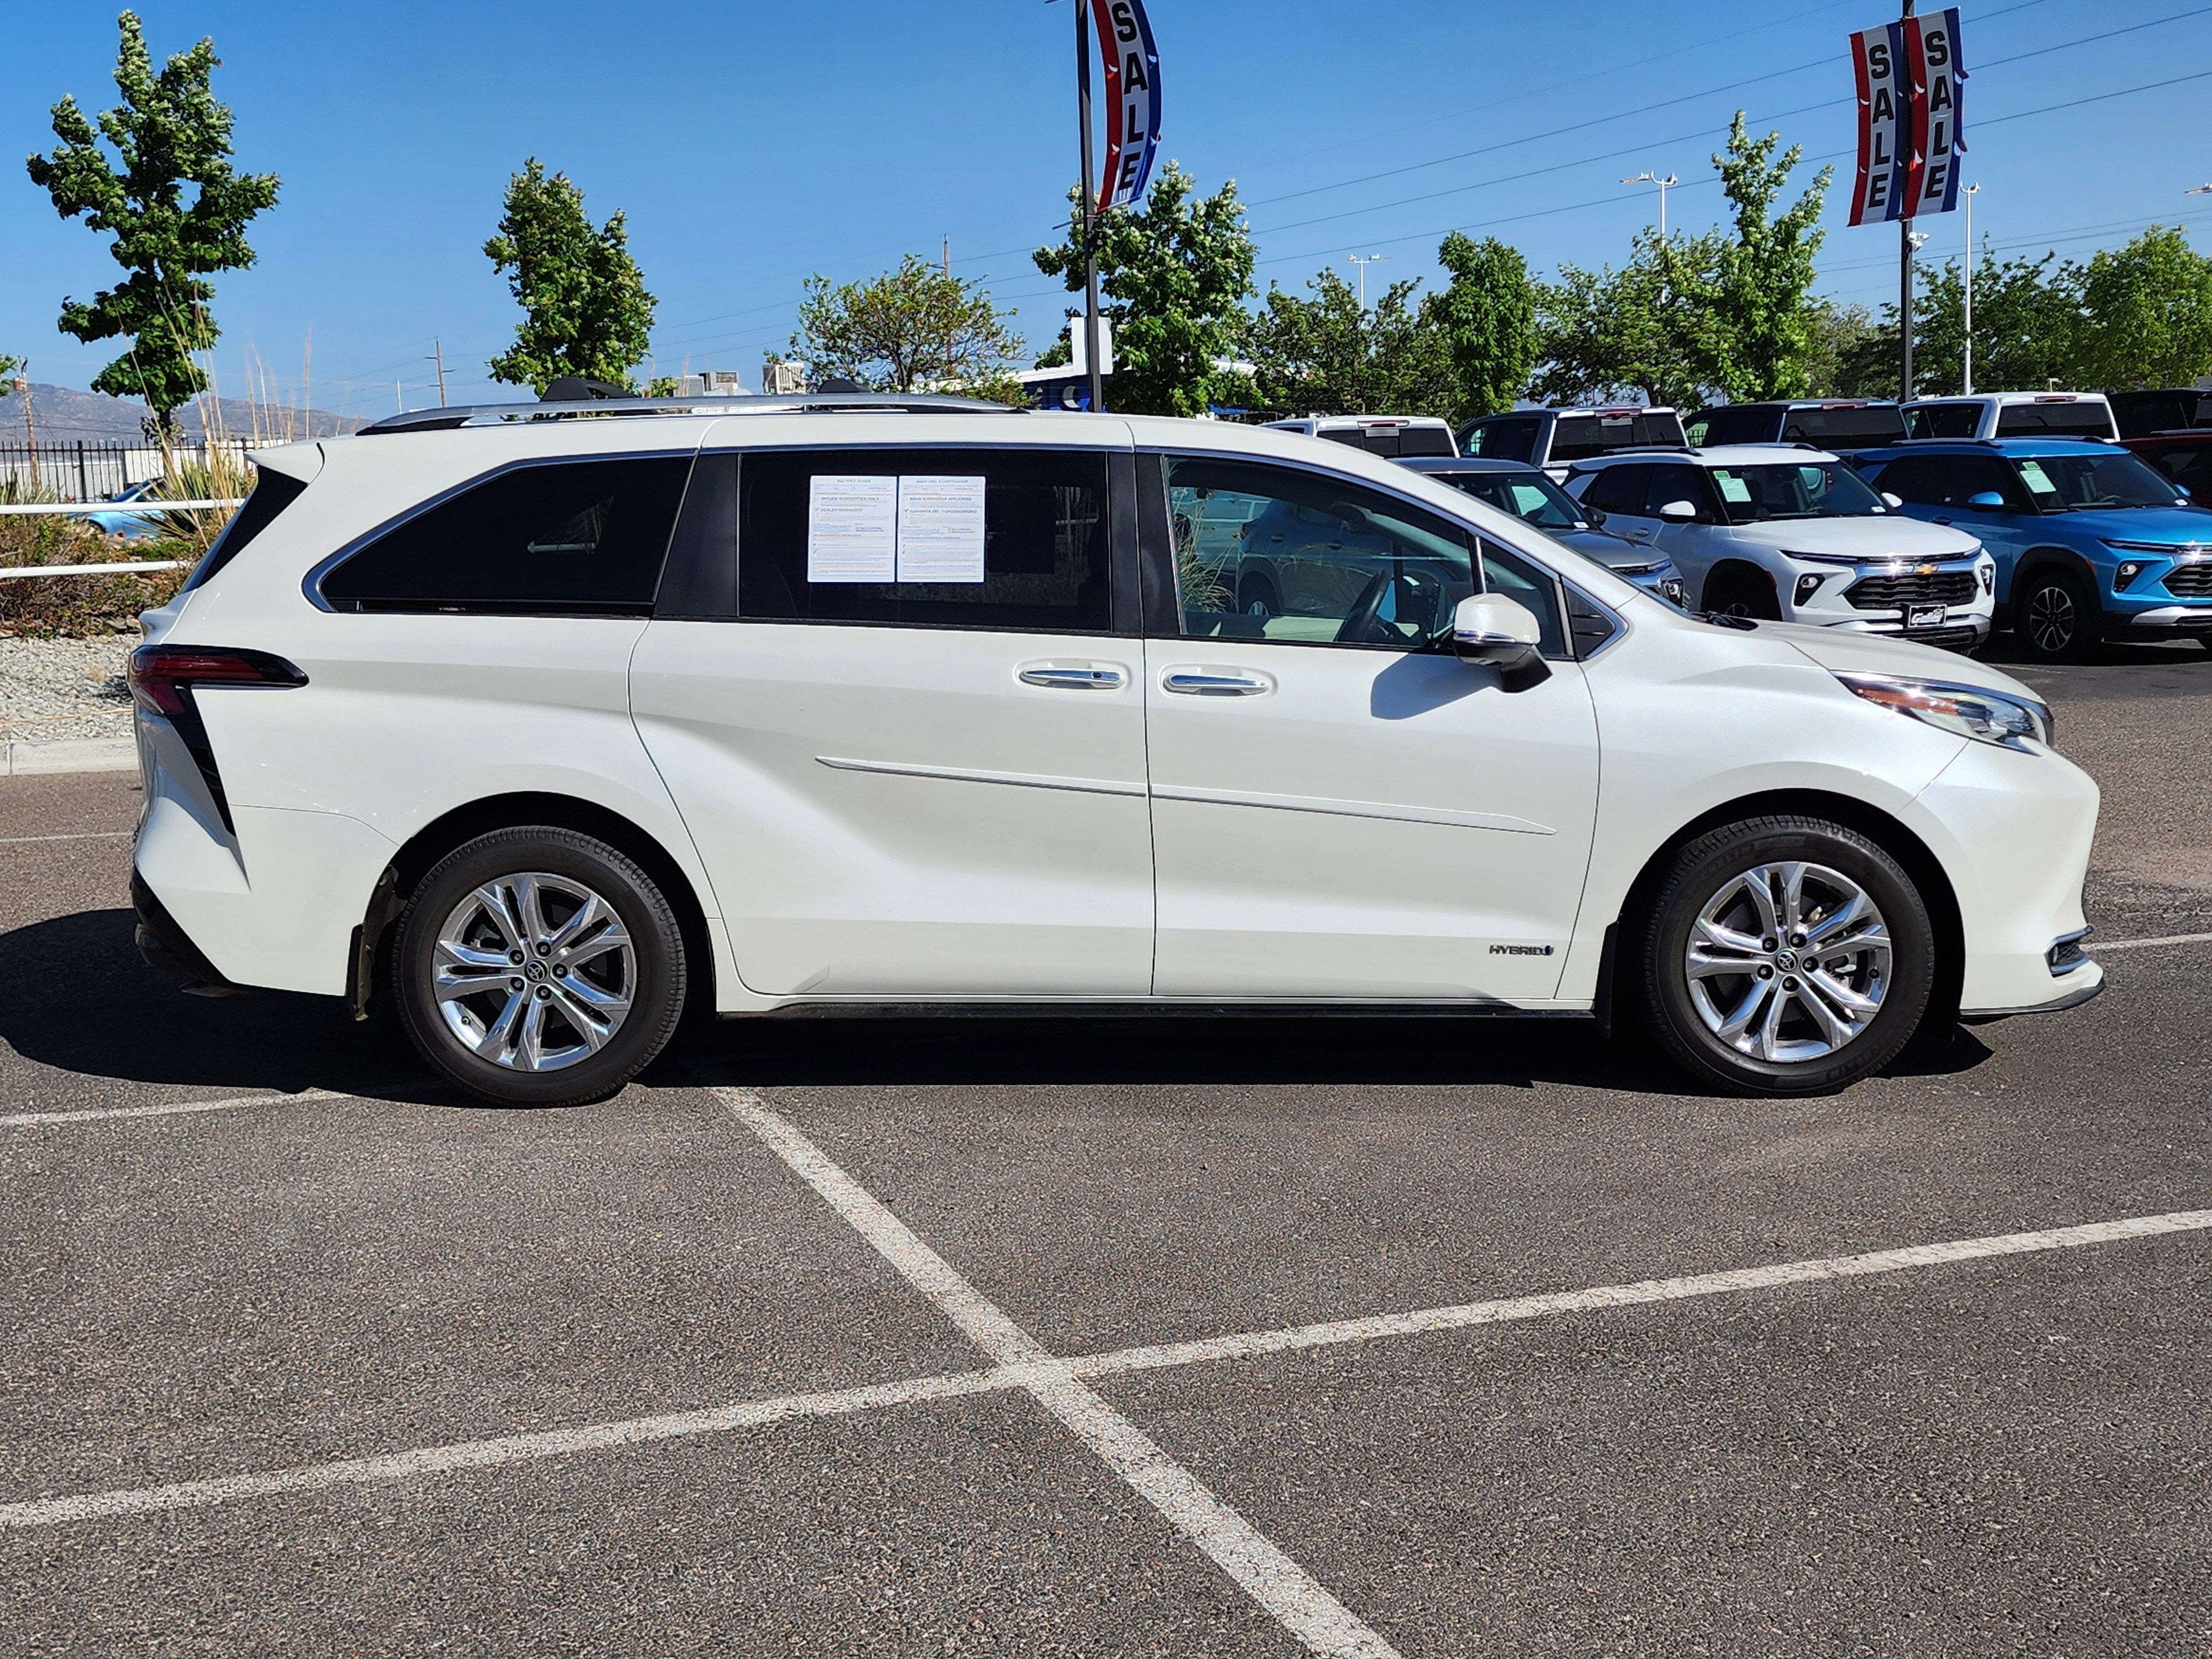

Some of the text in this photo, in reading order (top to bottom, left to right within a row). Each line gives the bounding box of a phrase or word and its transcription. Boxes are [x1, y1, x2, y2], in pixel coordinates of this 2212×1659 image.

[1111, 2, 1149, 190] SALE
[1868, 43, 1895, 208] SALE
[1924, 30, 1953, 199] SALE
[1489, 945, 1543, 956] HYBRID
